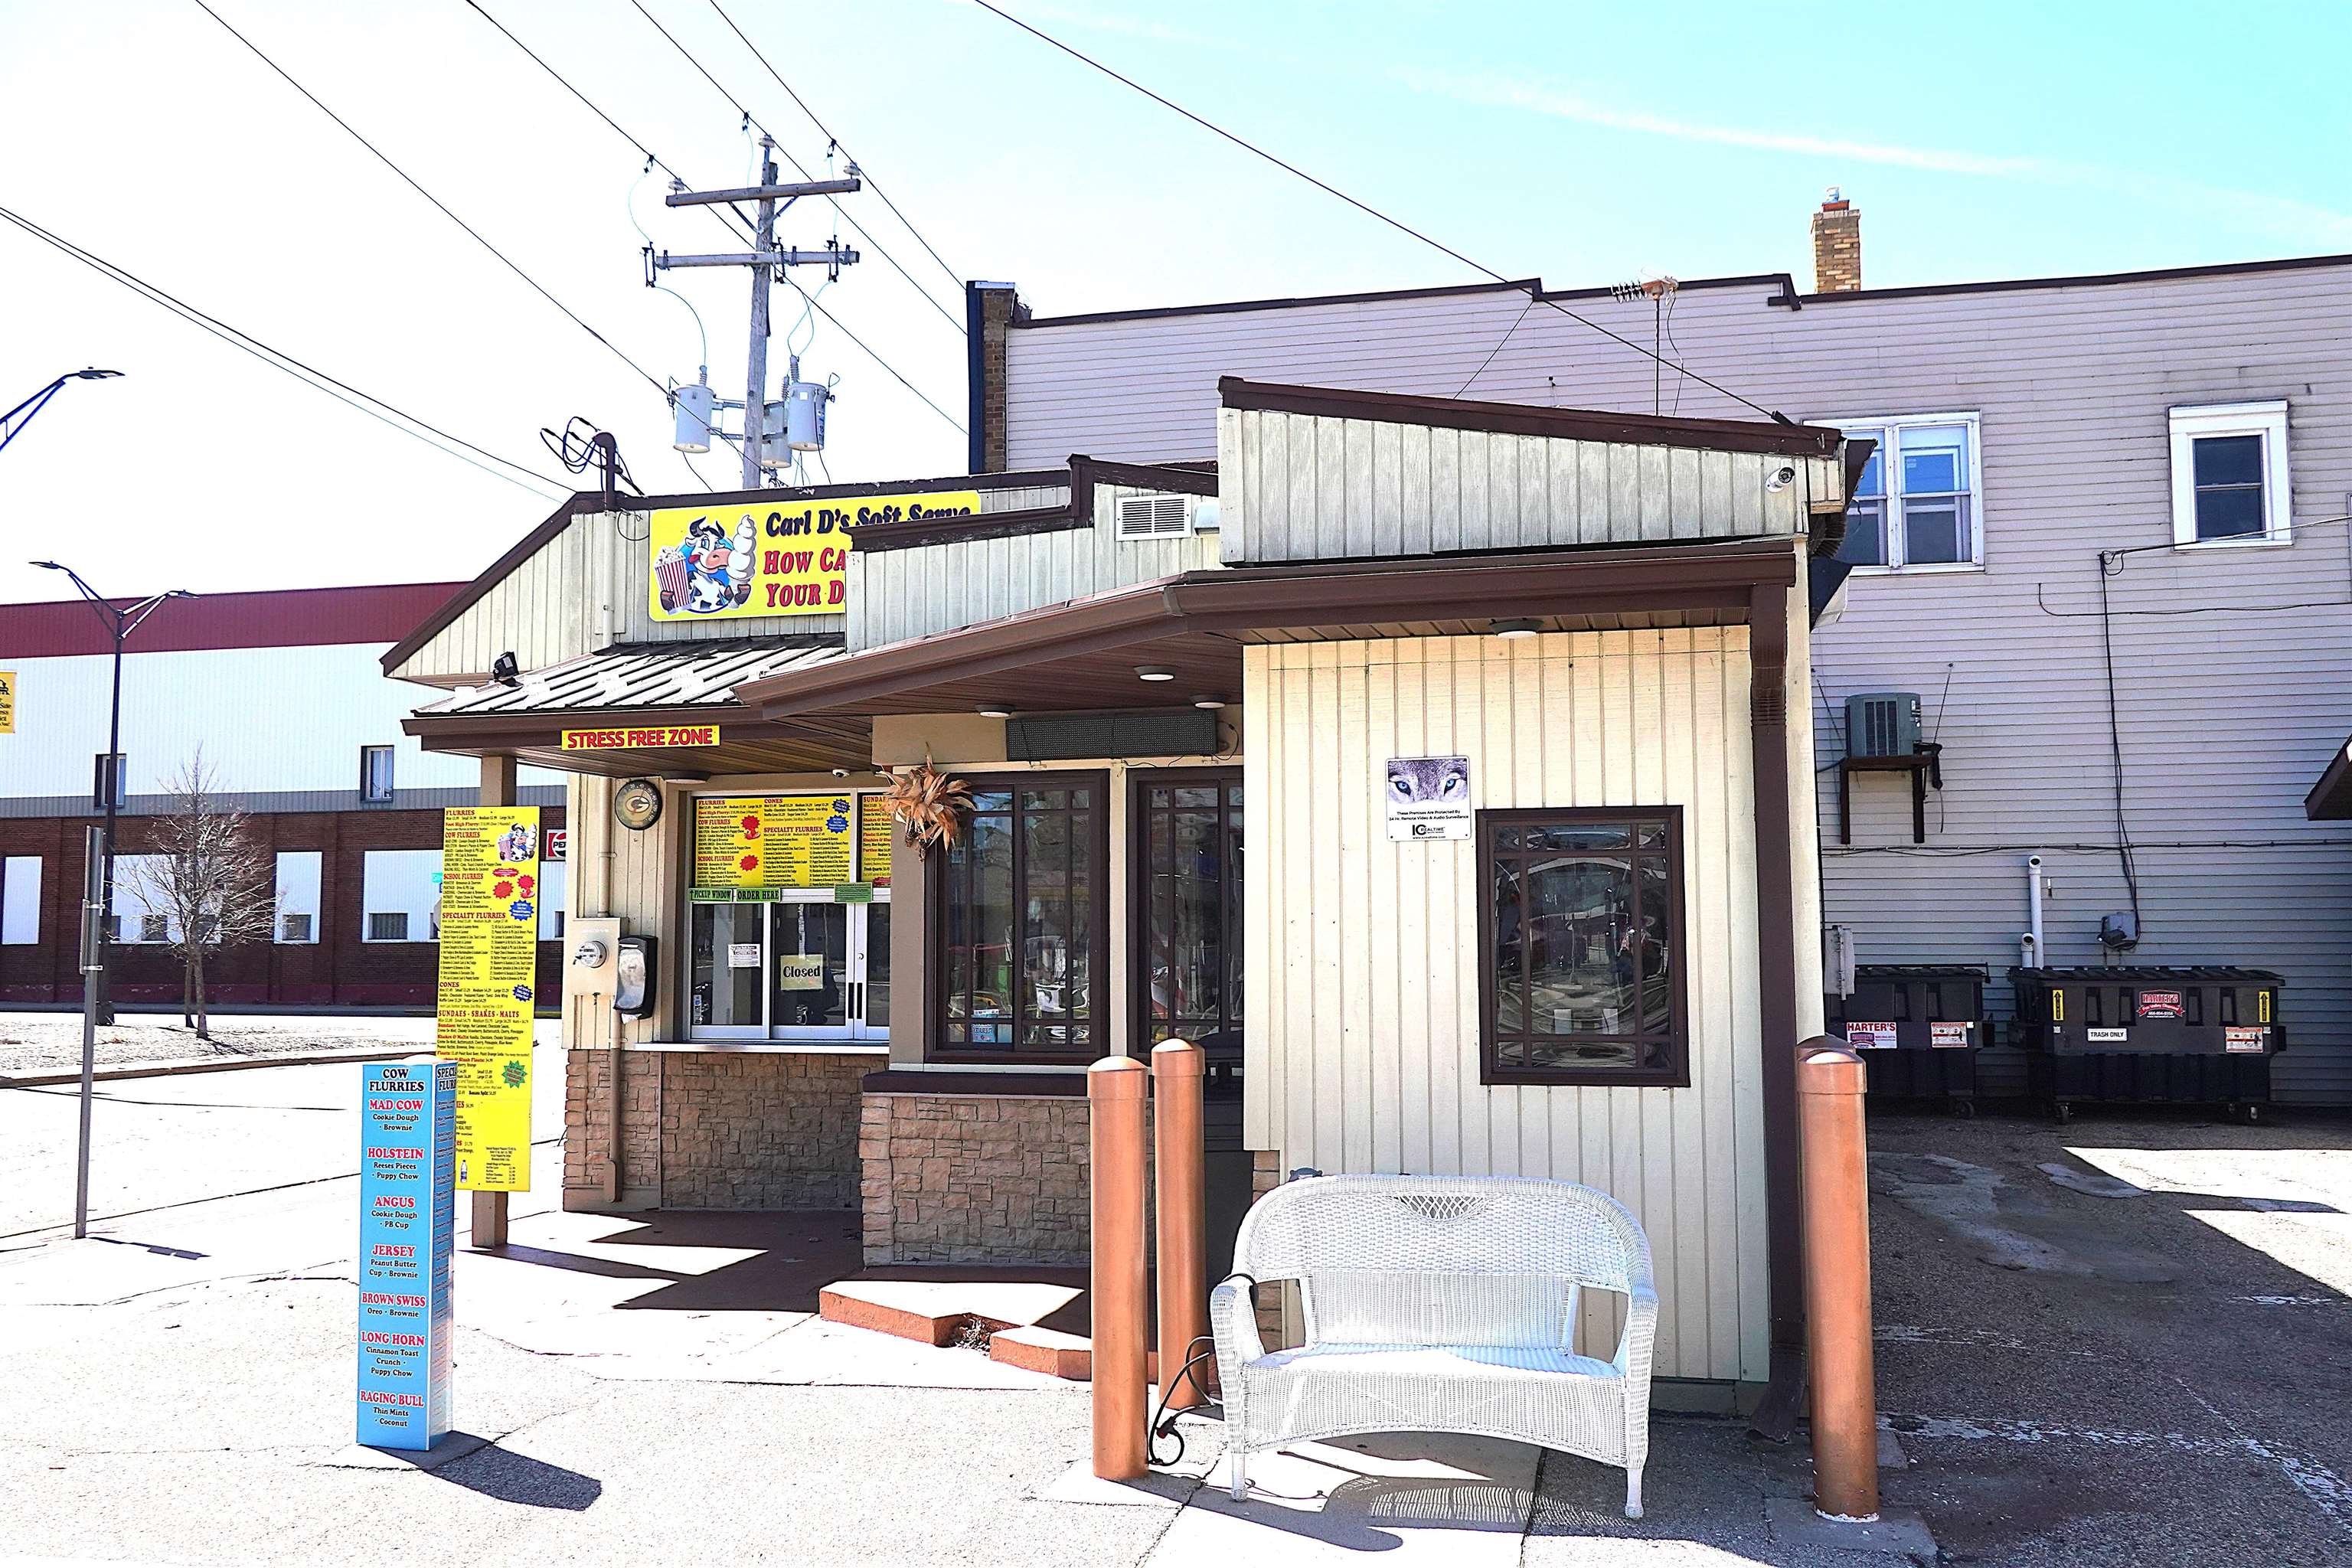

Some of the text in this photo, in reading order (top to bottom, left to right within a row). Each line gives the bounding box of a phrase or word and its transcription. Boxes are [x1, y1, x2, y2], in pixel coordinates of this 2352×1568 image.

[766, 510, 812, 537] Carl
[817, 508, 850, 534] D's
[763, 547, 845, 574] HOW CA
[766, 583, 821, 607] YOUR
[568, 728, 712, 748] STRESS FREE ZONE
[694, 890, 730, 899] PICKUP WINDOW
[737, 890, 779, 900] ORDER HERE
[783, 965, 820, 978] Closed
[1847, 1023, 1896, 1031] HARTER'S
[383, 1069, 408, 1079] COW
[437, 1068, 456, 1078] SPECI
[369, 1081, 424, 1091] FLURRIES
[439, 1080, 456, 1090] FLUR
[369, 1100, 423, 1110] MAD COW
[368, 1148, 423, 1158] HOLSTEIN
[375, 1197, 414, 1207] ANGUS
[373, 1245, 415, 1256] JERSEY
[362, 1292, 426, 1307] BROWN SWISS
[361, 1331, 425, 1346] LONG HORN
[366, 1347, 399, 1355] Cinnamon
[371, 1367, 390, 1376] Puppy
[360, 1391, 424, 1406] RAGING BULL
